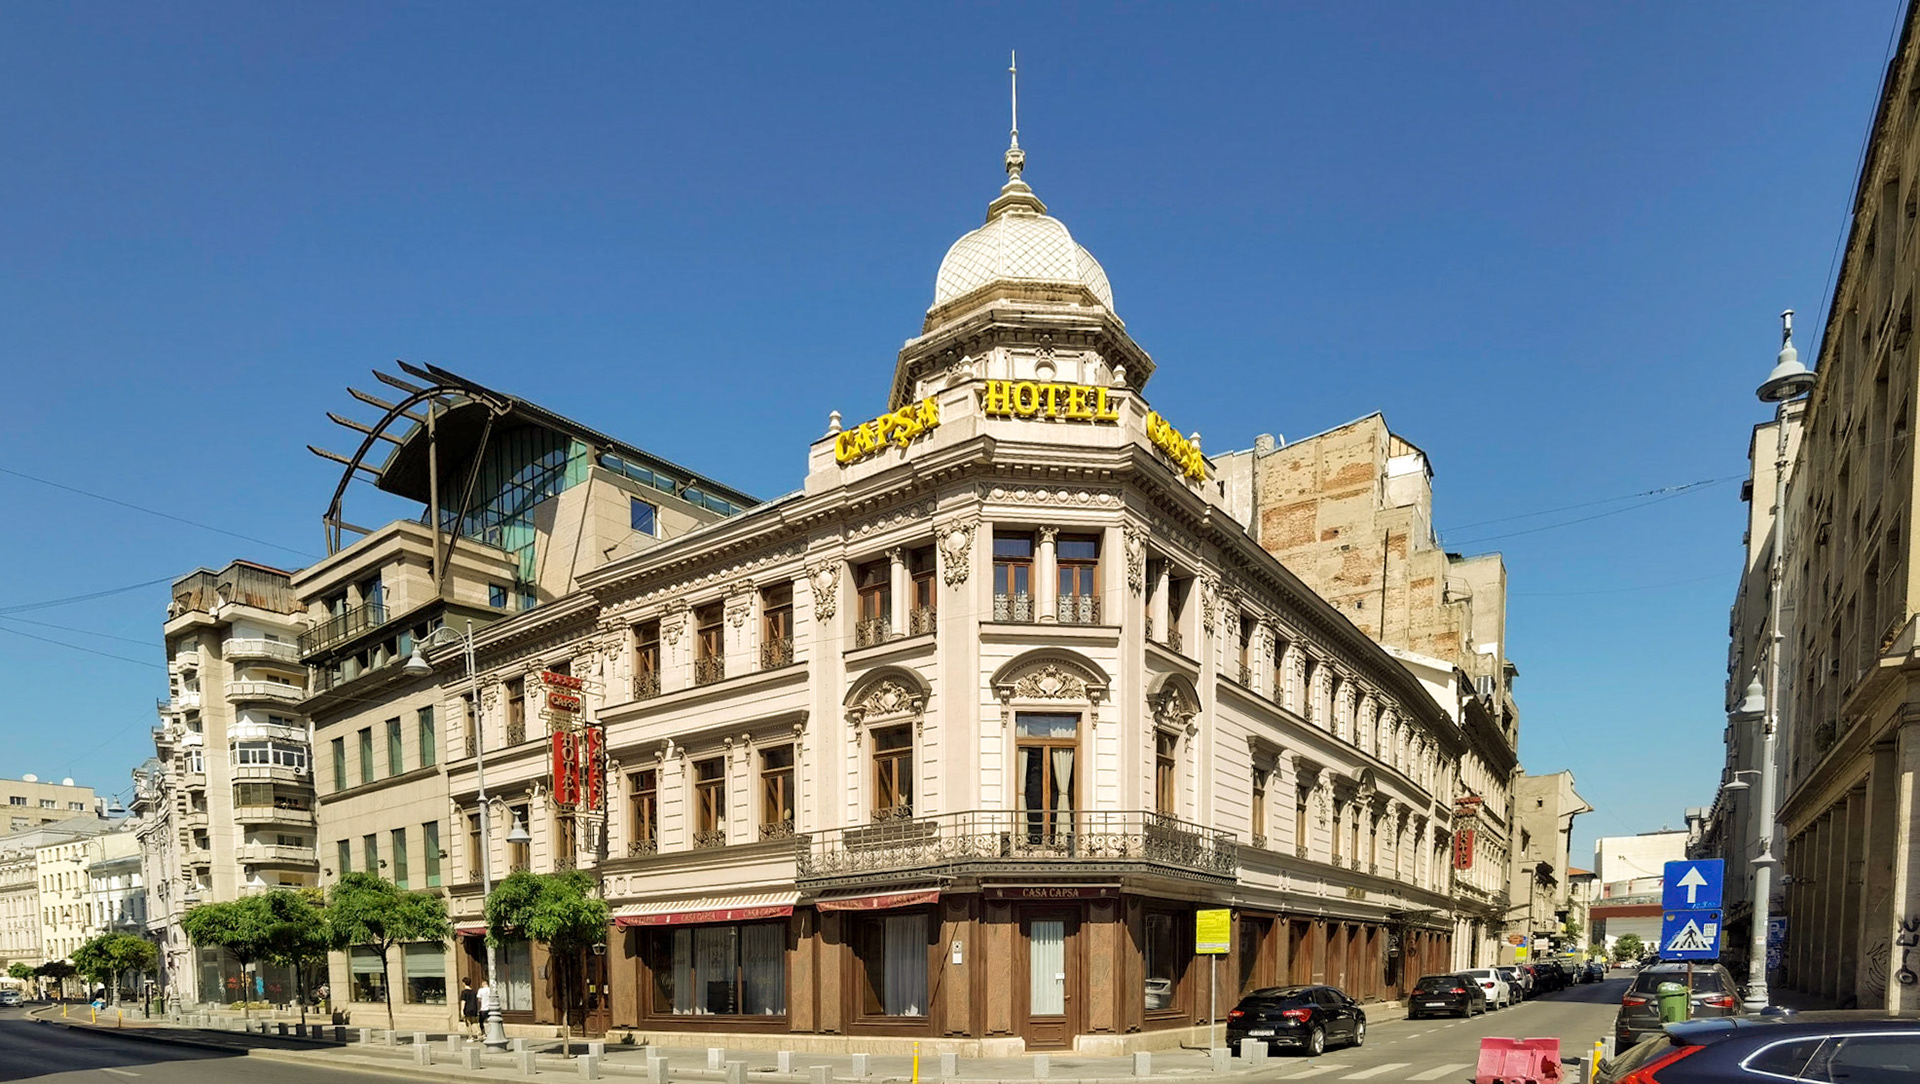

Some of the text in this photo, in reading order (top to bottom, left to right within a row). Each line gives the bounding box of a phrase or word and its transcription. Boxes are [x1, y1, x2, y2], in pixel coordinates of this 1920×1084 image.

[984, 380, 1119, 420] HOTEL
[561, 731, 576, 804] HOTEL
[1022, 888, 1047, 897] CASA
